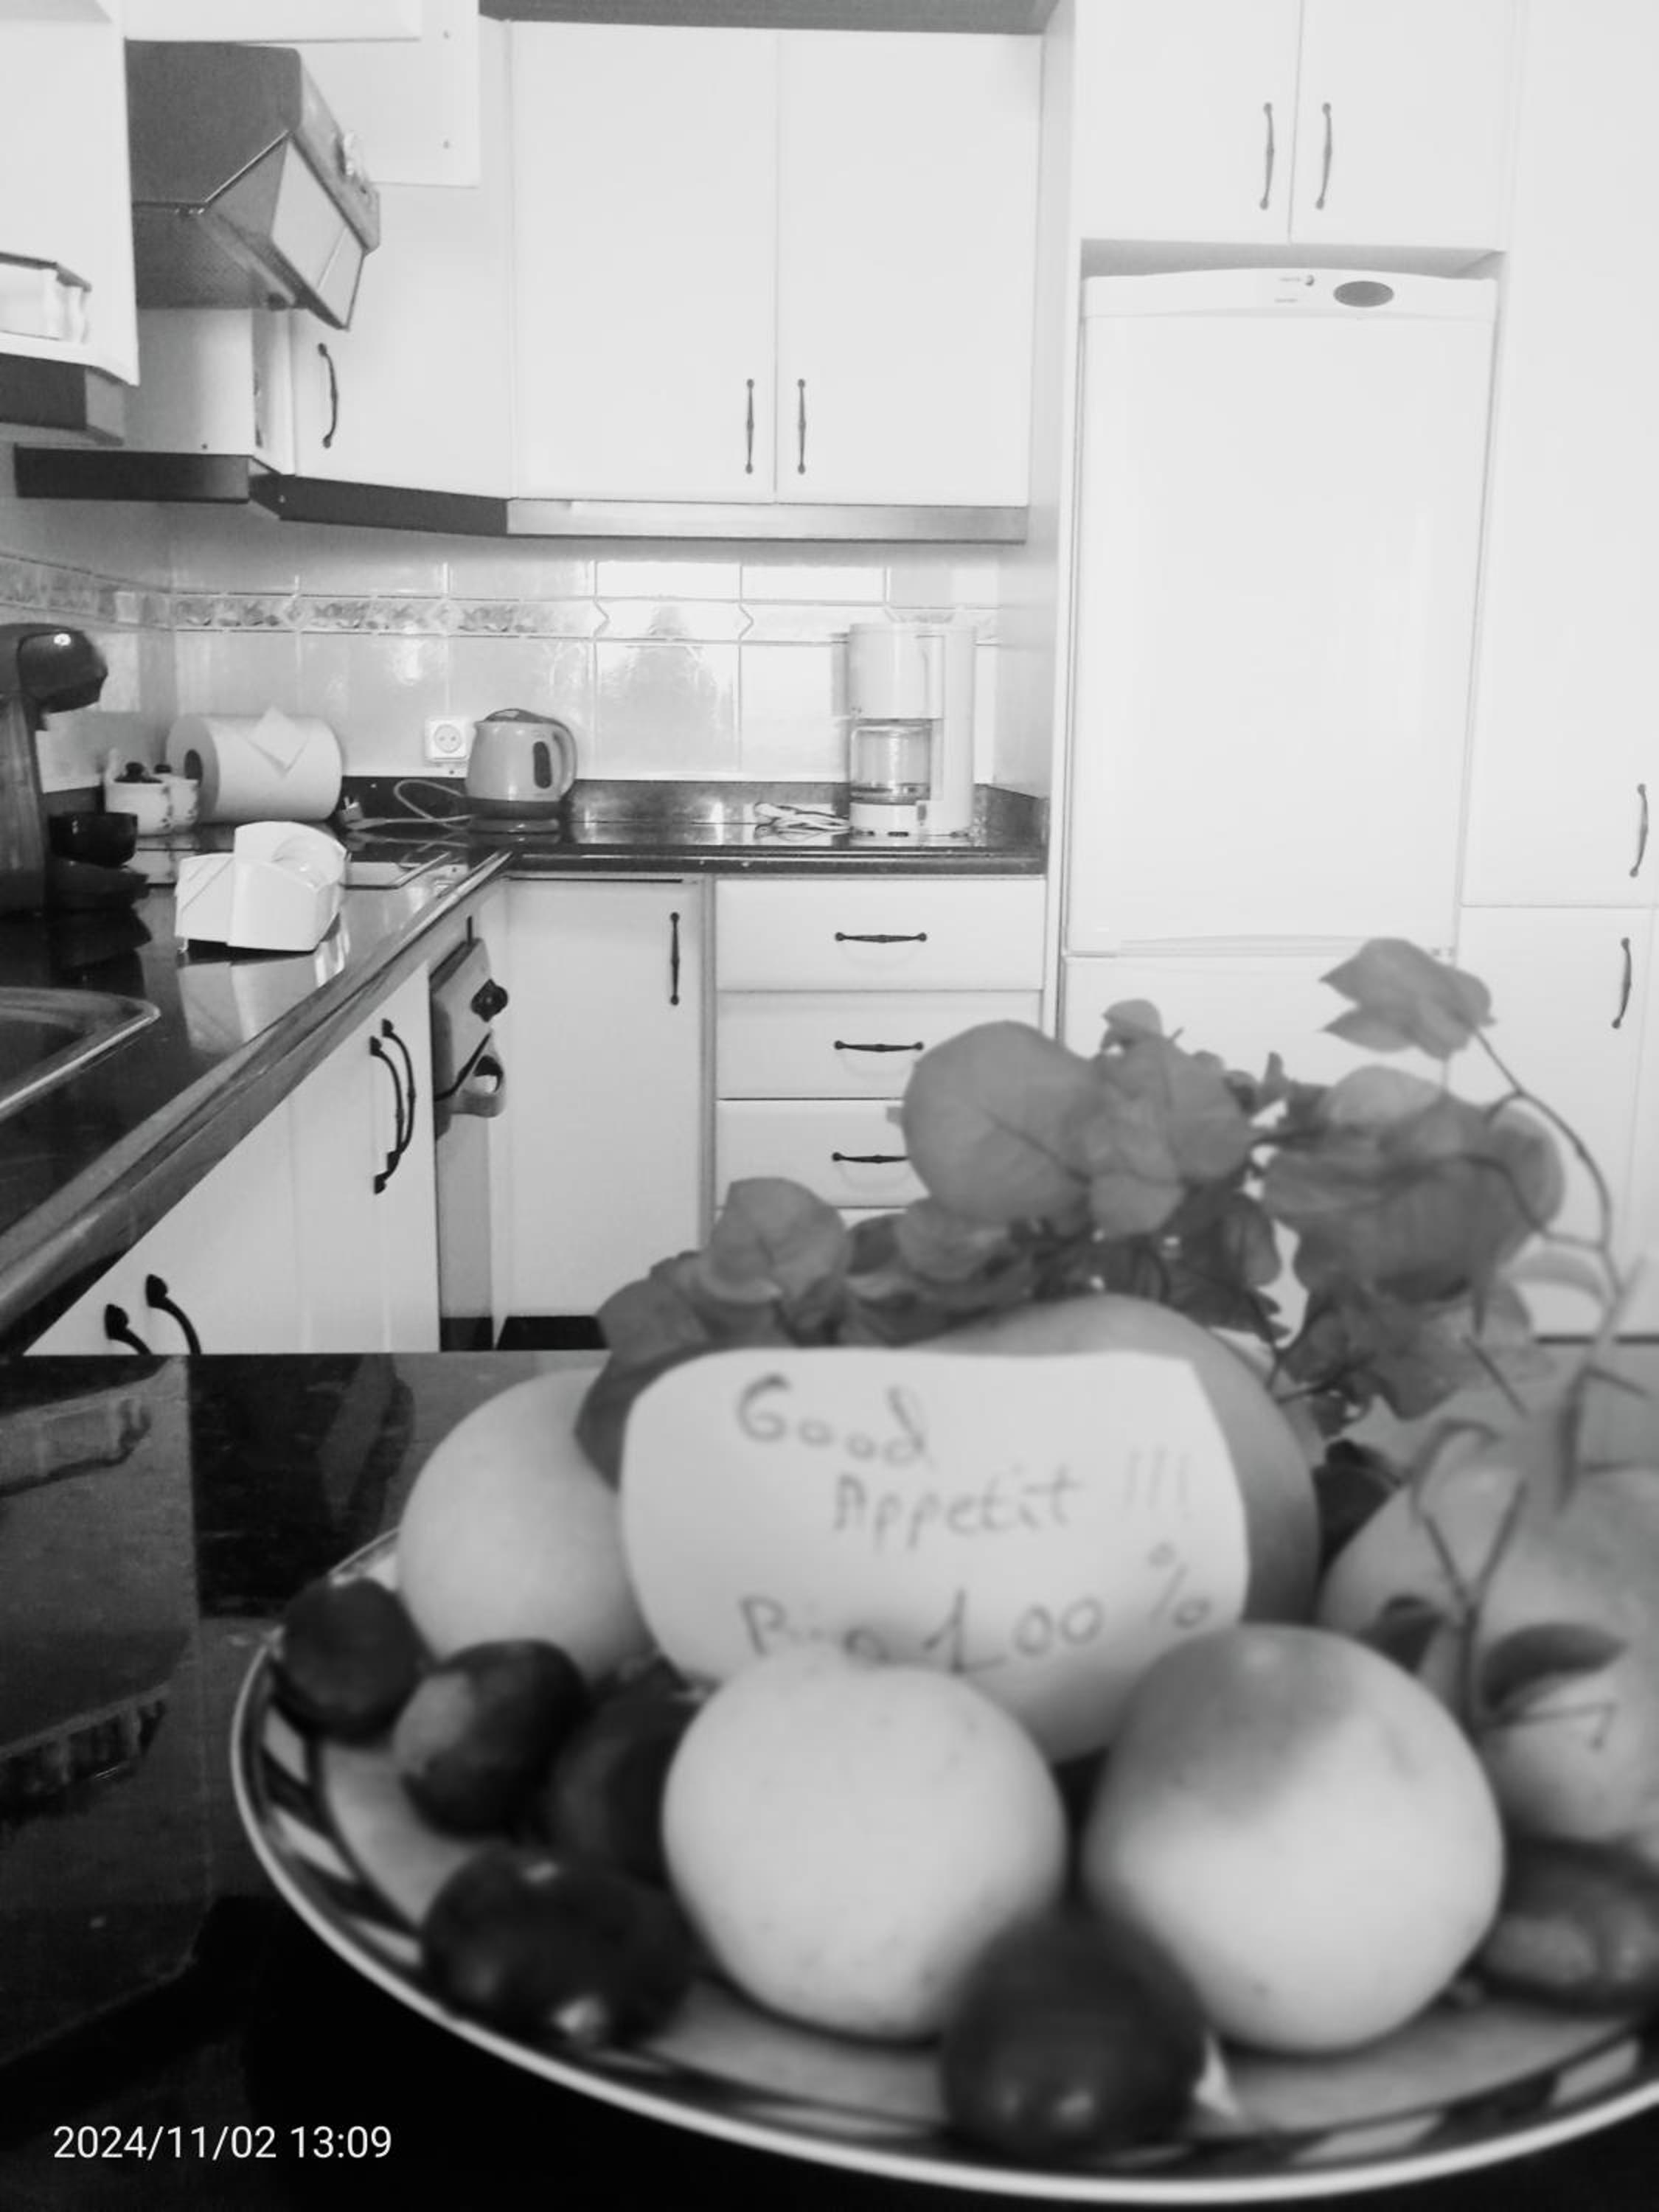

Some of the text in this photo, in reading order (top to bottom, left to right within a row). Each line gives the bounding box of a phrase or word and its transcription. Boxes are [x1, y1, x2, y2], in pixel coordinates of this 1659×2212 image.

[737, 1373, 932, 1469] Good
[832, 1466, 1082, 1552] Appetit
[737, 1591, 894, 1669] Bo
